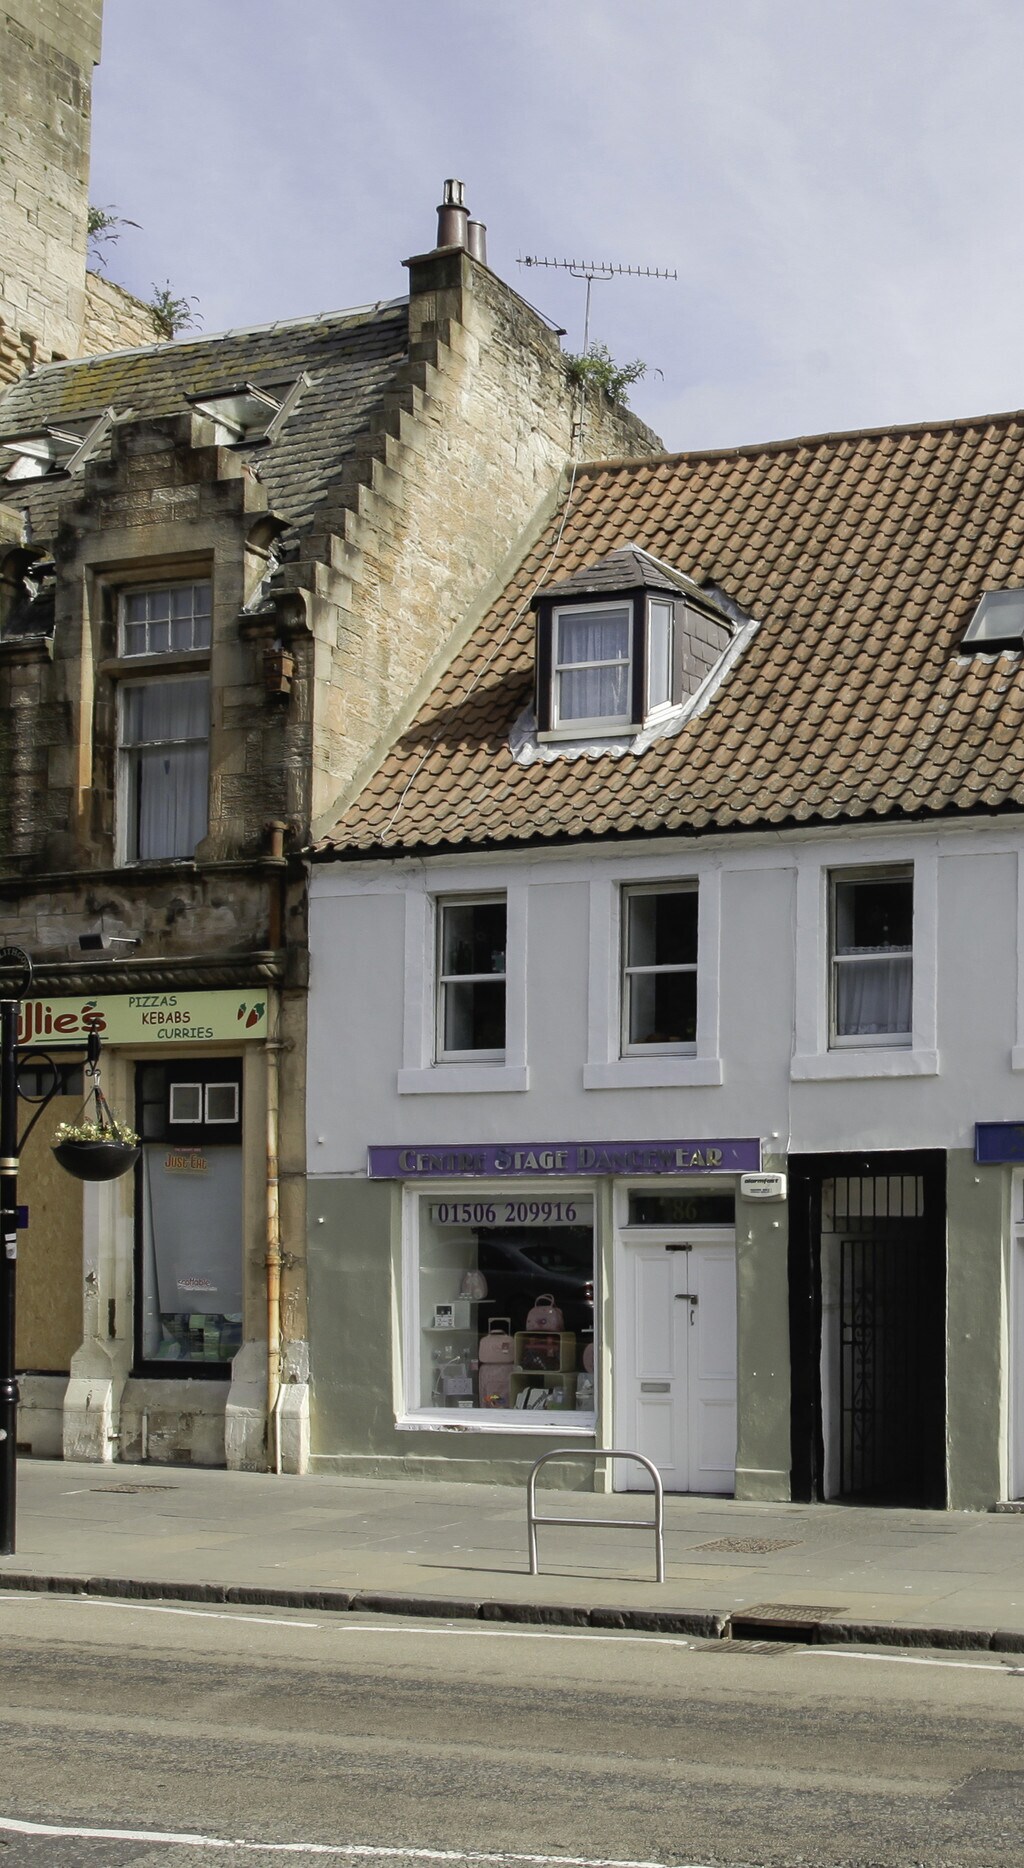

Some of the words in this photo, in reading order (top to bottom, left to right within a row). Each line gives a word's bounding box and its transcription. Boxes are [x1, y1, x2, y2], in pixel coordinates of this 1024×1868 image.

[128, 995, 178, 1008] PIZZAS
[141, 1011, 191, 1025] KEBABS
[157, 1026, 214, 1039] CURRIES
[438, 1203, 496, 1223] 01506
[504, 1202, 577, 1223] 209916
